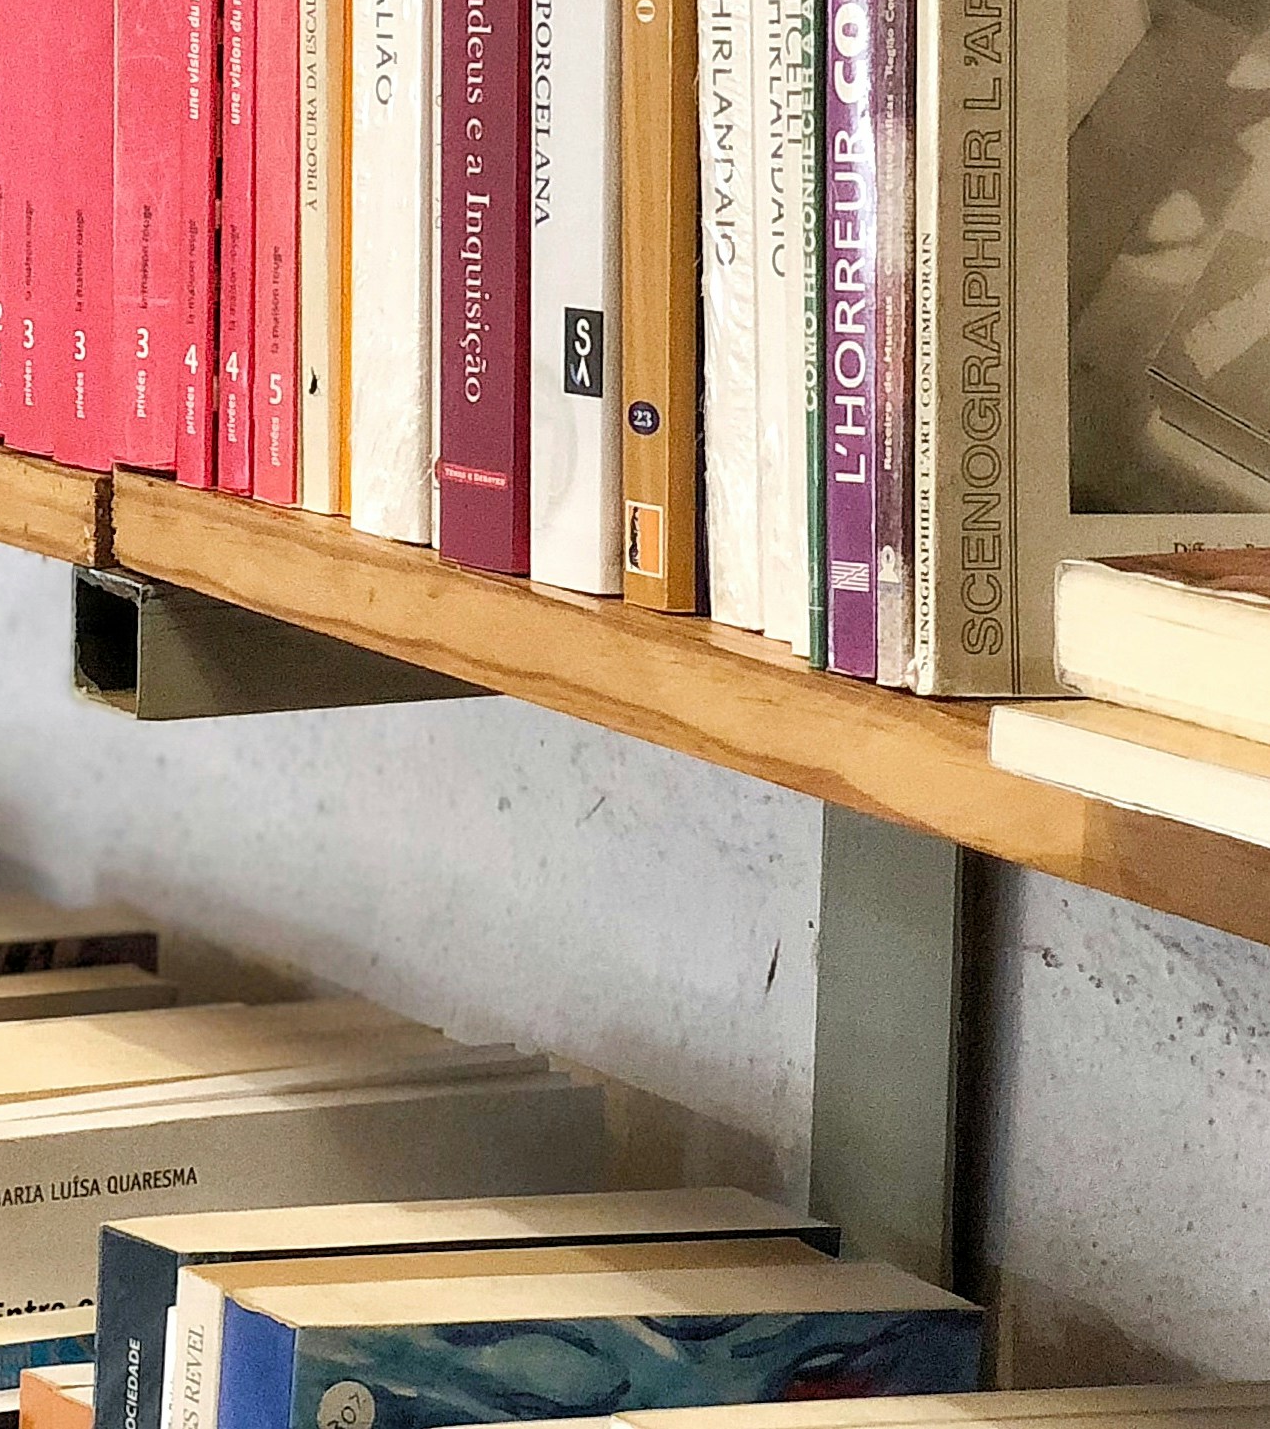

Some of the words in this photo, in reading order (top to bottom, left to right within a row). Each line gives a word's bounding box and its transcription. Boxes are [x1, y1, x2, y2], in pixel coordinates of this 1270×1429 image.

[187, 5, 200, 28] du
[187, 31, 200, 83] vision
[800, 32, 815, 64] A
[306, 62, 317, 91] DA
[189, 86, 200, 120] une
[533, 0, 551, 228] PORCELANA
[305, 97, 317, 192] PROCURA
[466, 116, 483, 141] e
[465, 153, 483, 178] a
[801, 68, 817, 299] RECONHECER
[272, 245, 282, 284] rouge
[271, 287, 280, 339] maison
[459, 190, 490, 403] Inquisição
[833, 128, 867, 485] L'HORREUR
[921, 231, 932, 409] CONTEMPORAIN
[22, 319, 35, 350] 3
[74, 330, 87, 362] 3
[135, 327, 149, 360] 3
[22, 359, 34, 407] privées
[184, 344, 198, 375] 4
[225, 351, 240, 382] 4
[802, 310, 819, 414] COMO
[74, 371, 86, 420] privées
[135, 370, 147, 419] privées
[184, 385, 196, 435] privées
[269, 373, 283, 405] 5
[959, 131, 1003, 657] SCENOGRAPHIER
[226, 393, 237, 443] privées
[269, 416, 281, 467] privées
[633, 409, 652, 428] 23
[919, 417, 931, 478] L'ART
[51, 1176, 101, 1201] LUÍSA
[106, 1167, 198, 1195] QUARESMA
[183, 1324, 205, 1405] REVEL
